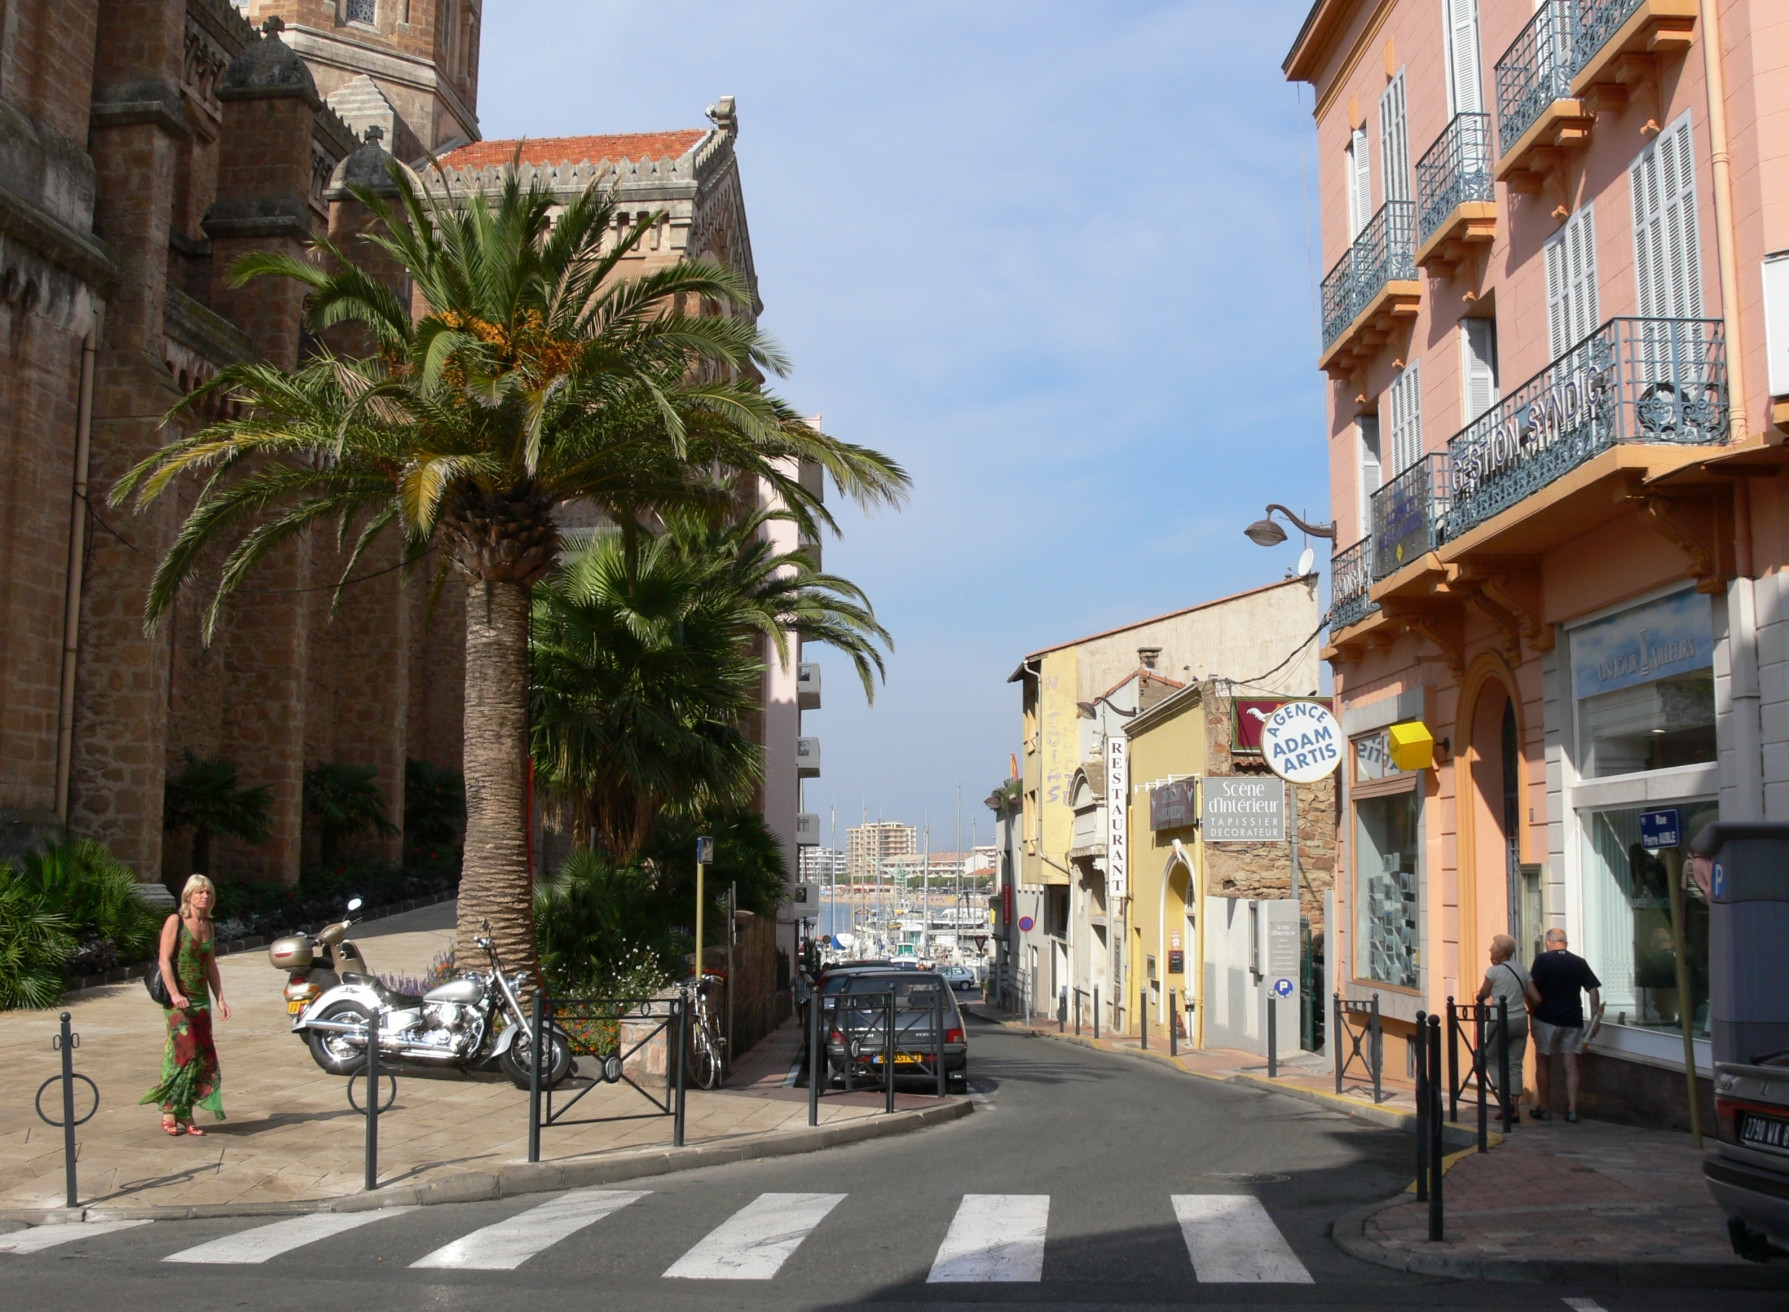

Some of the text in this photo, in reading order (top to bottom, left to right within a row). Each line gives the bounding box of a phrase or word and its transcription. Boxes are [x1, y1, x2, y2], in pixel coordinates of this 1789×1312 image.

[1451, 365, 1601, 494] GESTION SYNDIC
[1613, 654, 1638, 679] JOUR
[1651, 639, 1697, 669] AILLEURS
[1266, 703, 1328, 738] AGENCE
[1273, 725, 1333, 759] ADAM
[1284, 743, 1337, 774] ARTIS
[1223, 781, 1265, 797] Scène
[1208, 796, 1280, 813] d'Intérieur
[1111, 742, 1124, 892] RESTAURANT
[1210, 818, 1278, 826] TAPISSIER
[1655, 815, 1667, 825] Rue
[1210, 828, 1278, 837] DECORATEUR
[1643, 834, 1658, 846] Pierre
[1279, 981, 1289, 992] P
